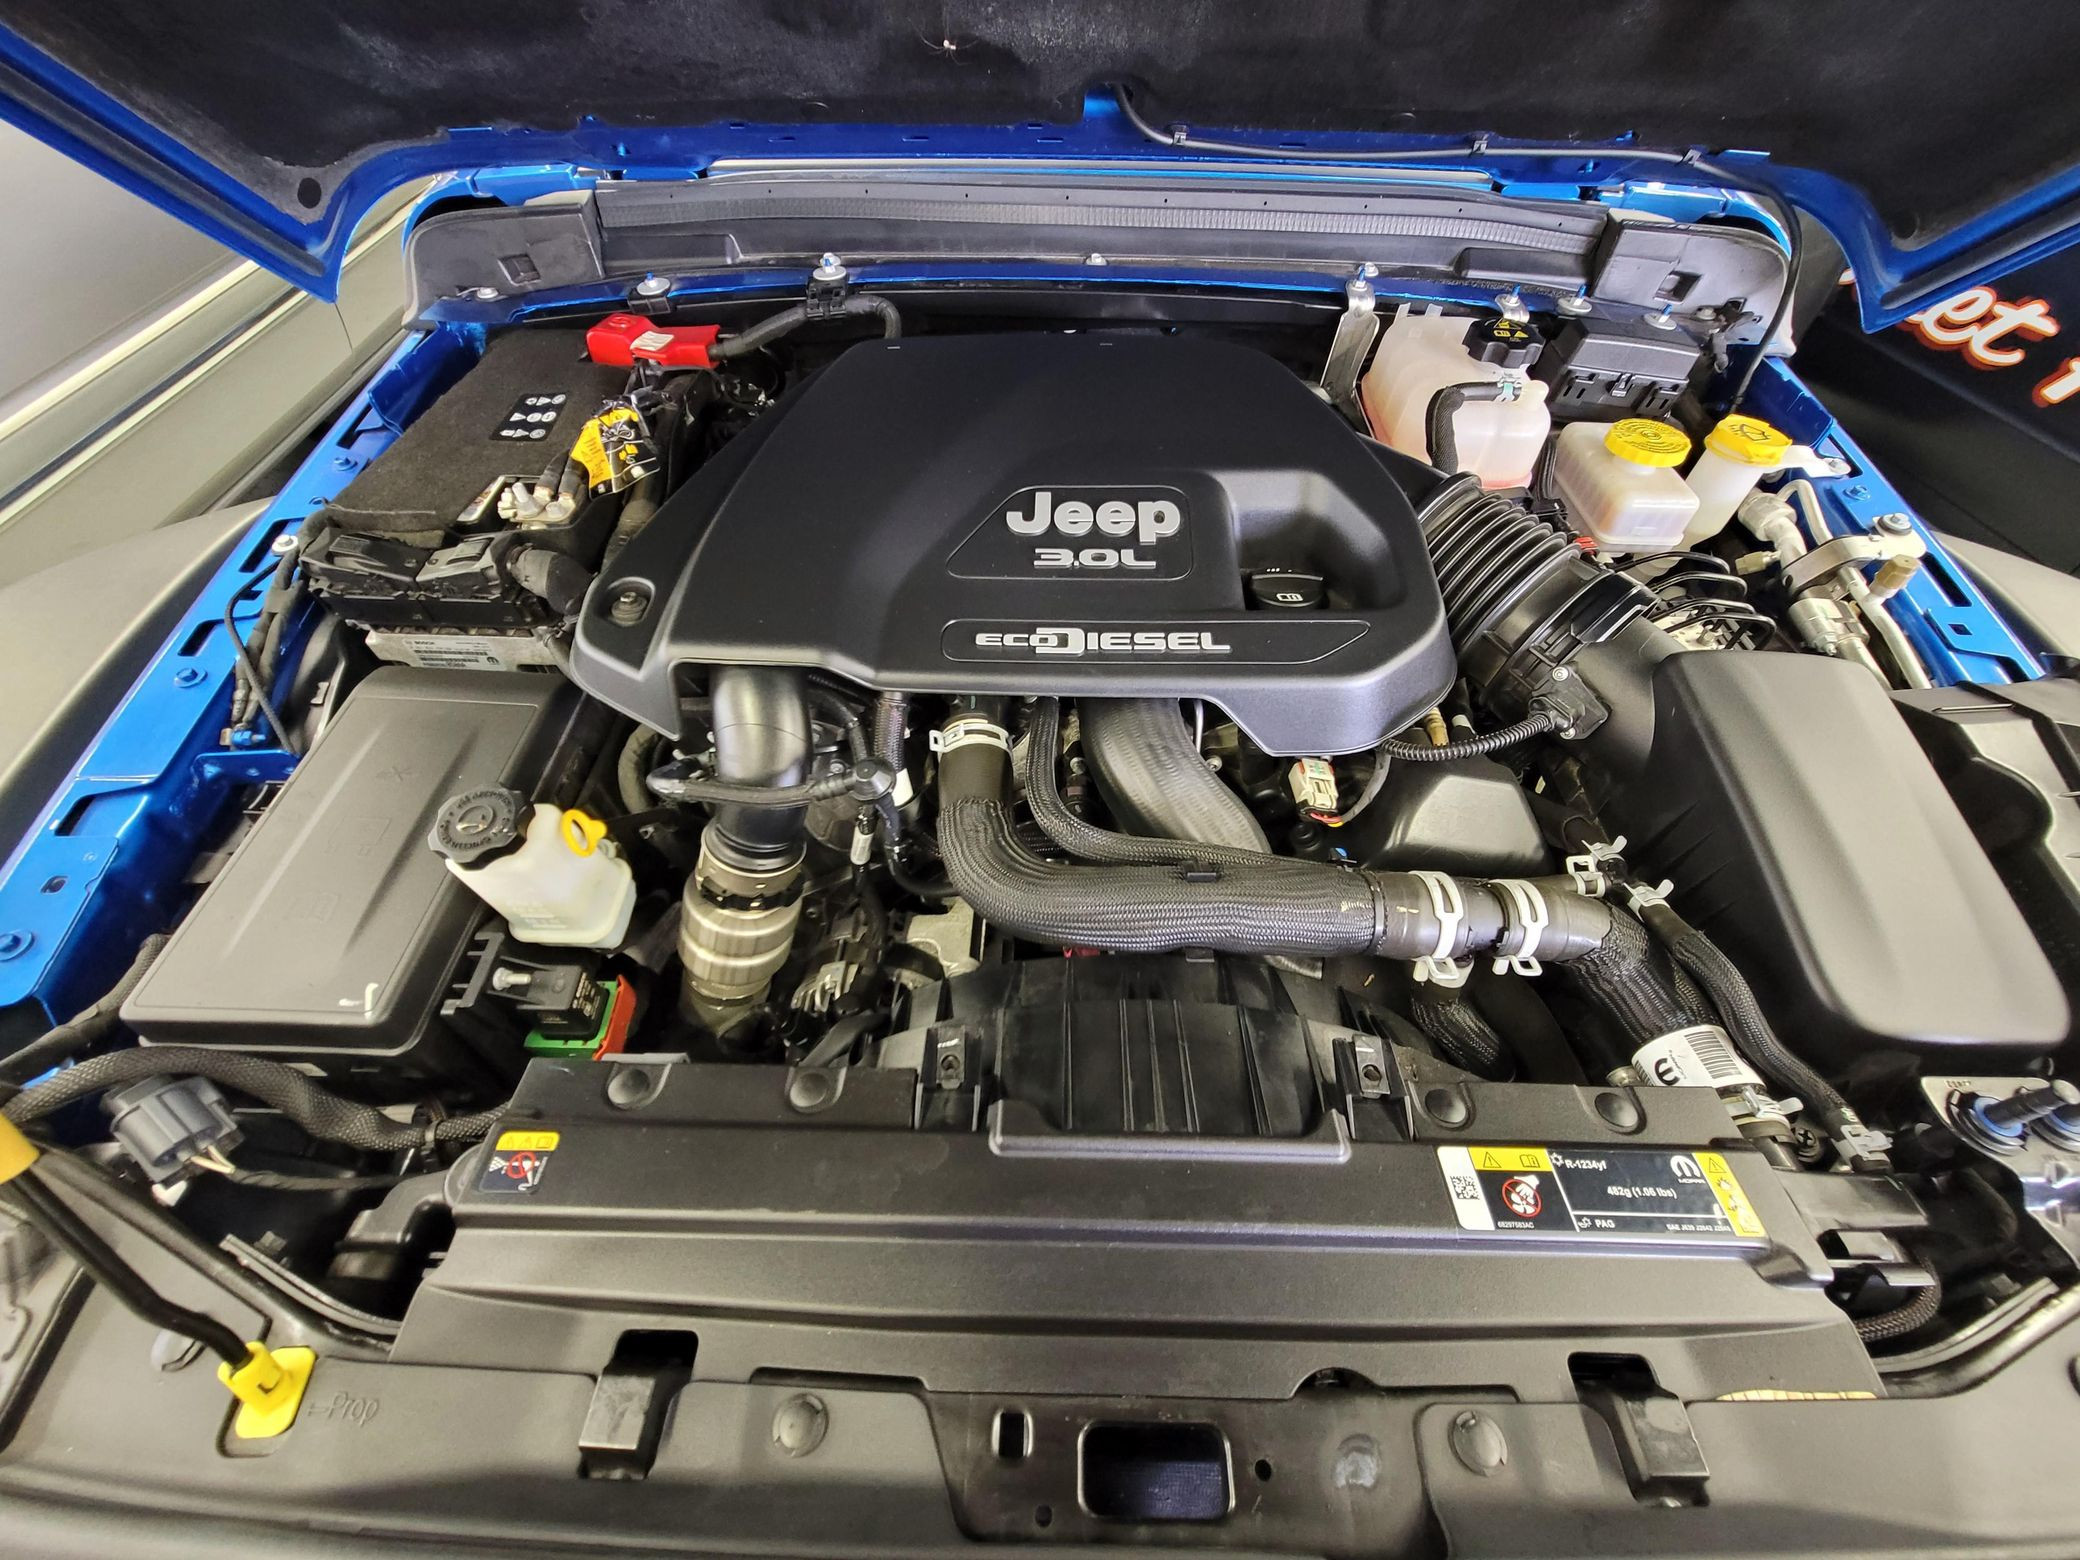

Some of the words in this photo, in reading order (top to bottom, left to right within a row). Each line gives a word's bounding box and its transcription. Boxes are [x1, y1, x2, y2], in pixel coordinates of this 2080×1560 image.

[1006, 491, 1181, 545] Jeep
[1033, 548, 1157, 569] 3.0L
[1607, 1185, 1633, 1198] 482g
[1656, 1187, 1678, 1200] lbs)
[1594, 1219, 1616, 1229] PAG
[327, 1390, 381, 1428] Prop
